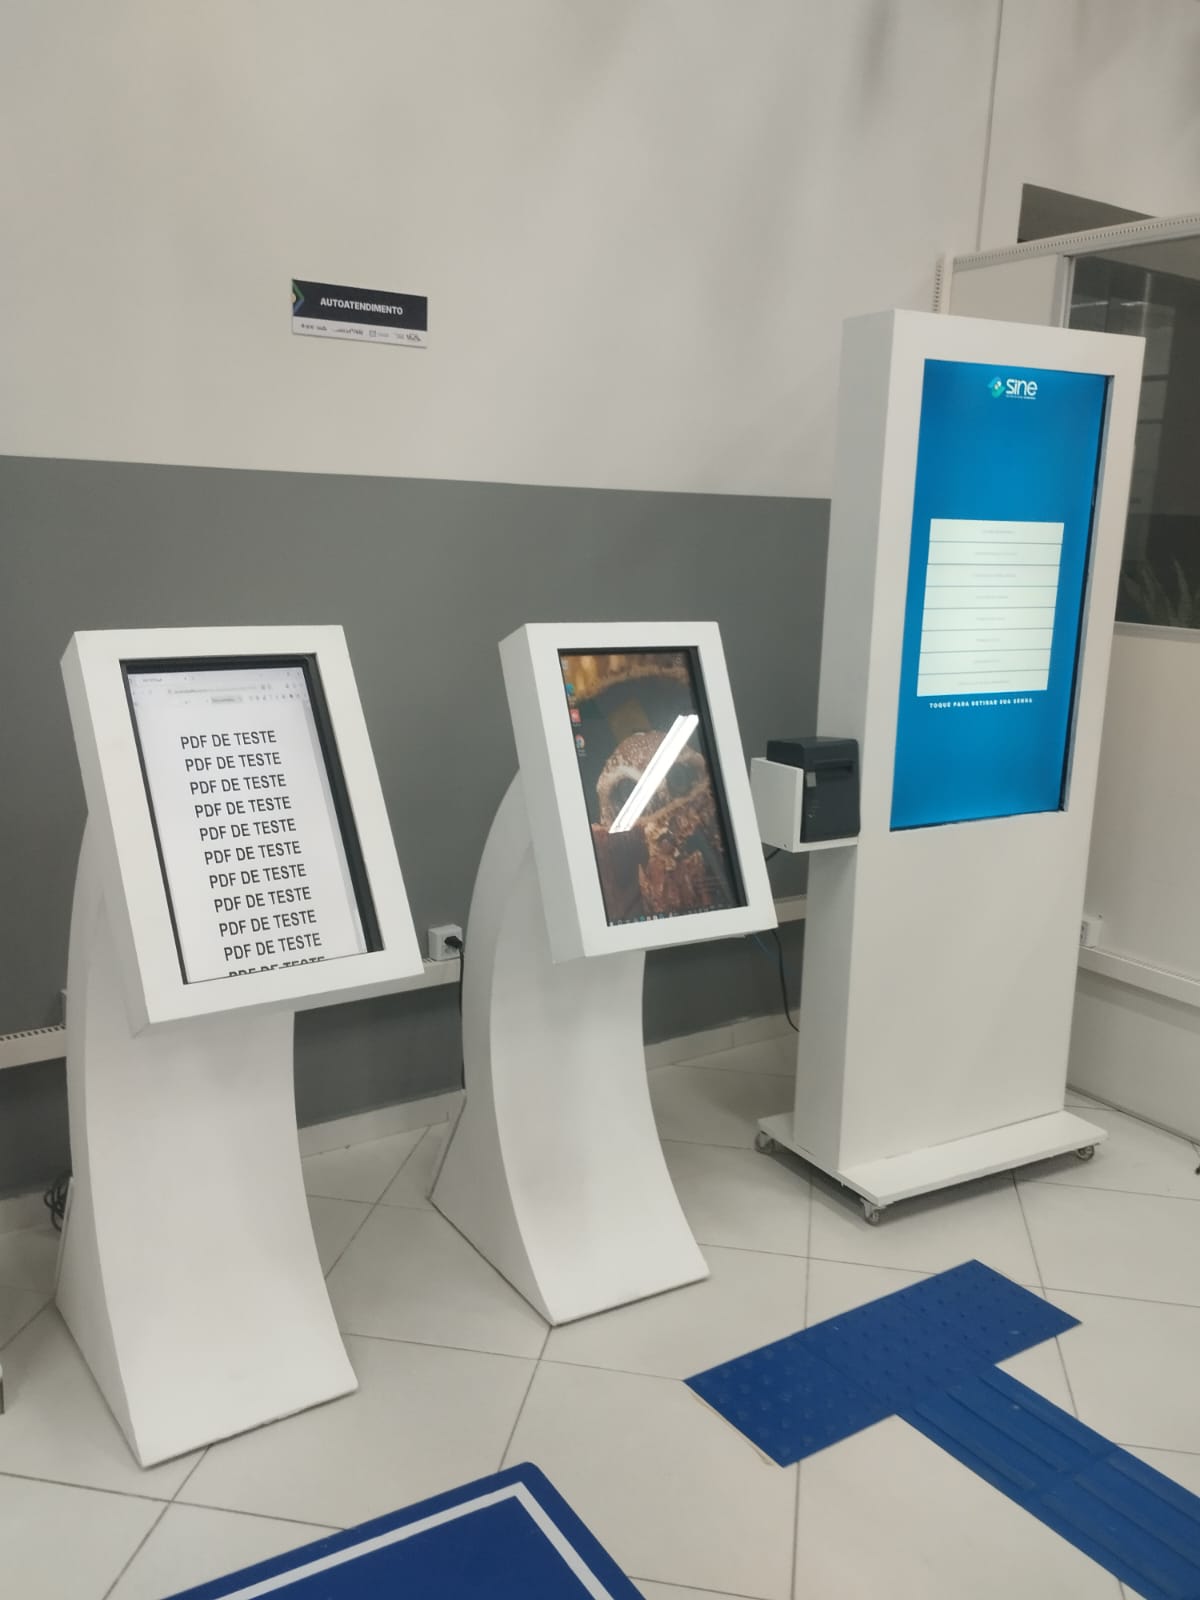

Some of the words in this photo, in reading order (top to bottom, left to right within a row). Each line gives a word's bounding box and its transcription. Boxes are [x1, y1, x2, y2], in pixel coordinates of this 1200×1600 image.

[320, 297, 403, 315] AUTOATENDIMENTO
[1005, 378, 1038, 396] sine
[180, 734, 208, 750] PDF
[211, 733, 232, 748] DE
[233, 729, 277, 746] TESTE
[184, 756, 213, 773] PDF
[215, 755, 236, 770] DE
[237, 751, 282, 768] TESTE
[189, 779, 217, 796] PDF
[220, 777, 241, 793] DE
[242, 773, 287, 791] TESTE
[194, 802, 222, 819] PDF
[225, 800, 246, 816] DE
[247, 795, 292, 813] TESTE
[199, 825, 227, 842] PDF
[230, 823, 251, 838] DE
[252, 817, 297, 836] TESTE
[203, 848, 232, 866] PDF
[235, 845, 256, 862] DE
[257, 840, 302, 859] TESTE
[208, 872, 237, 889] PDF
[240, 868, 261, 885] DE
[262, 863, 307, 882] TESTE
[213, 895, 242, 913] PDF
[245, 892, 266, 909] DE
[267, 885, 312, 905] TESTE
[218, 919, 247, 938] PDF
[250, 916, 271, 933] DE
[272, 909, 317, 929] TESTE
[223, 943, 252, 962] PDF
[255, 939, 276, 956] DE
[277, 932, 323, 953] TESTE
